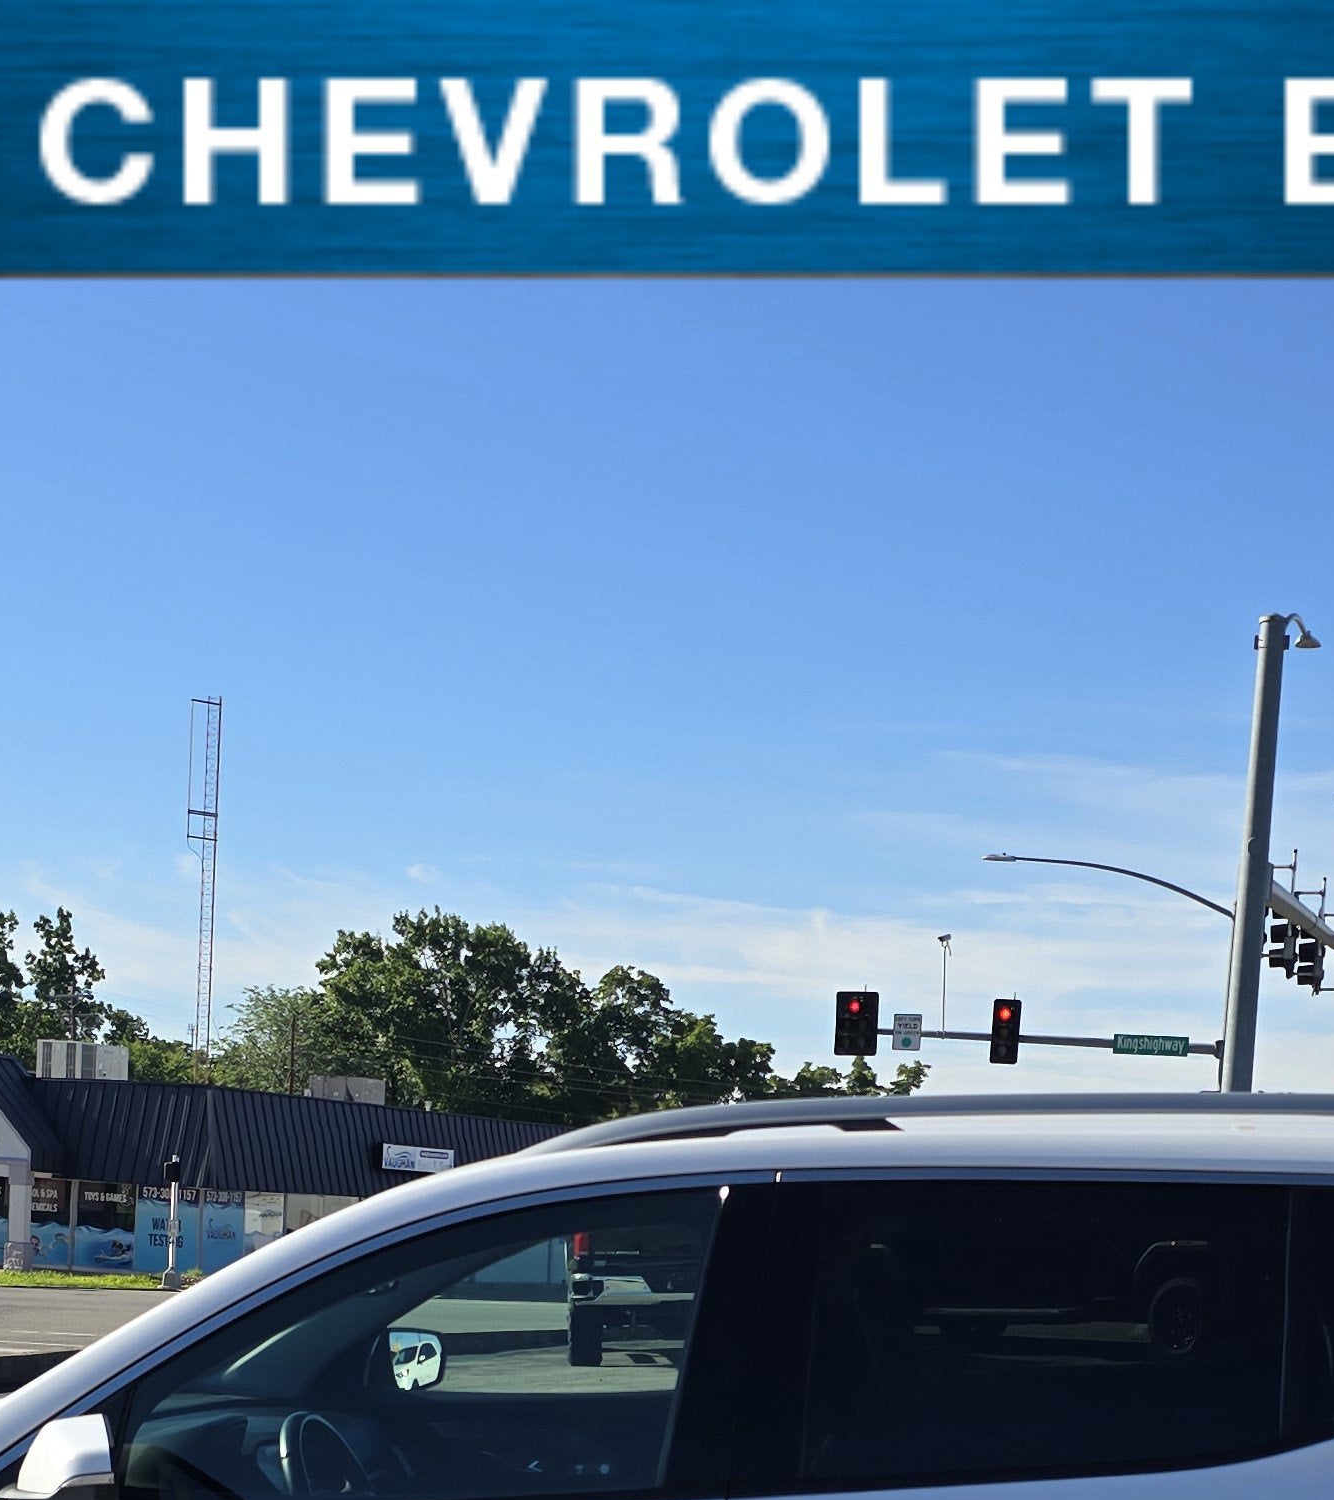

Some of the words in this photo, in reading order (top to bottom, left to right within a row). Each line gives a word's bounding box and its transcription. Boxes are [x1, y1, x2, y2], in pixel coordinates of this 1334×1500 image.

[1116, 1035, 1185, 1055] Kingshighway
[84, 1191, 100, 1202] TOYS
[105, 1192, 128, 1203] GAMES
